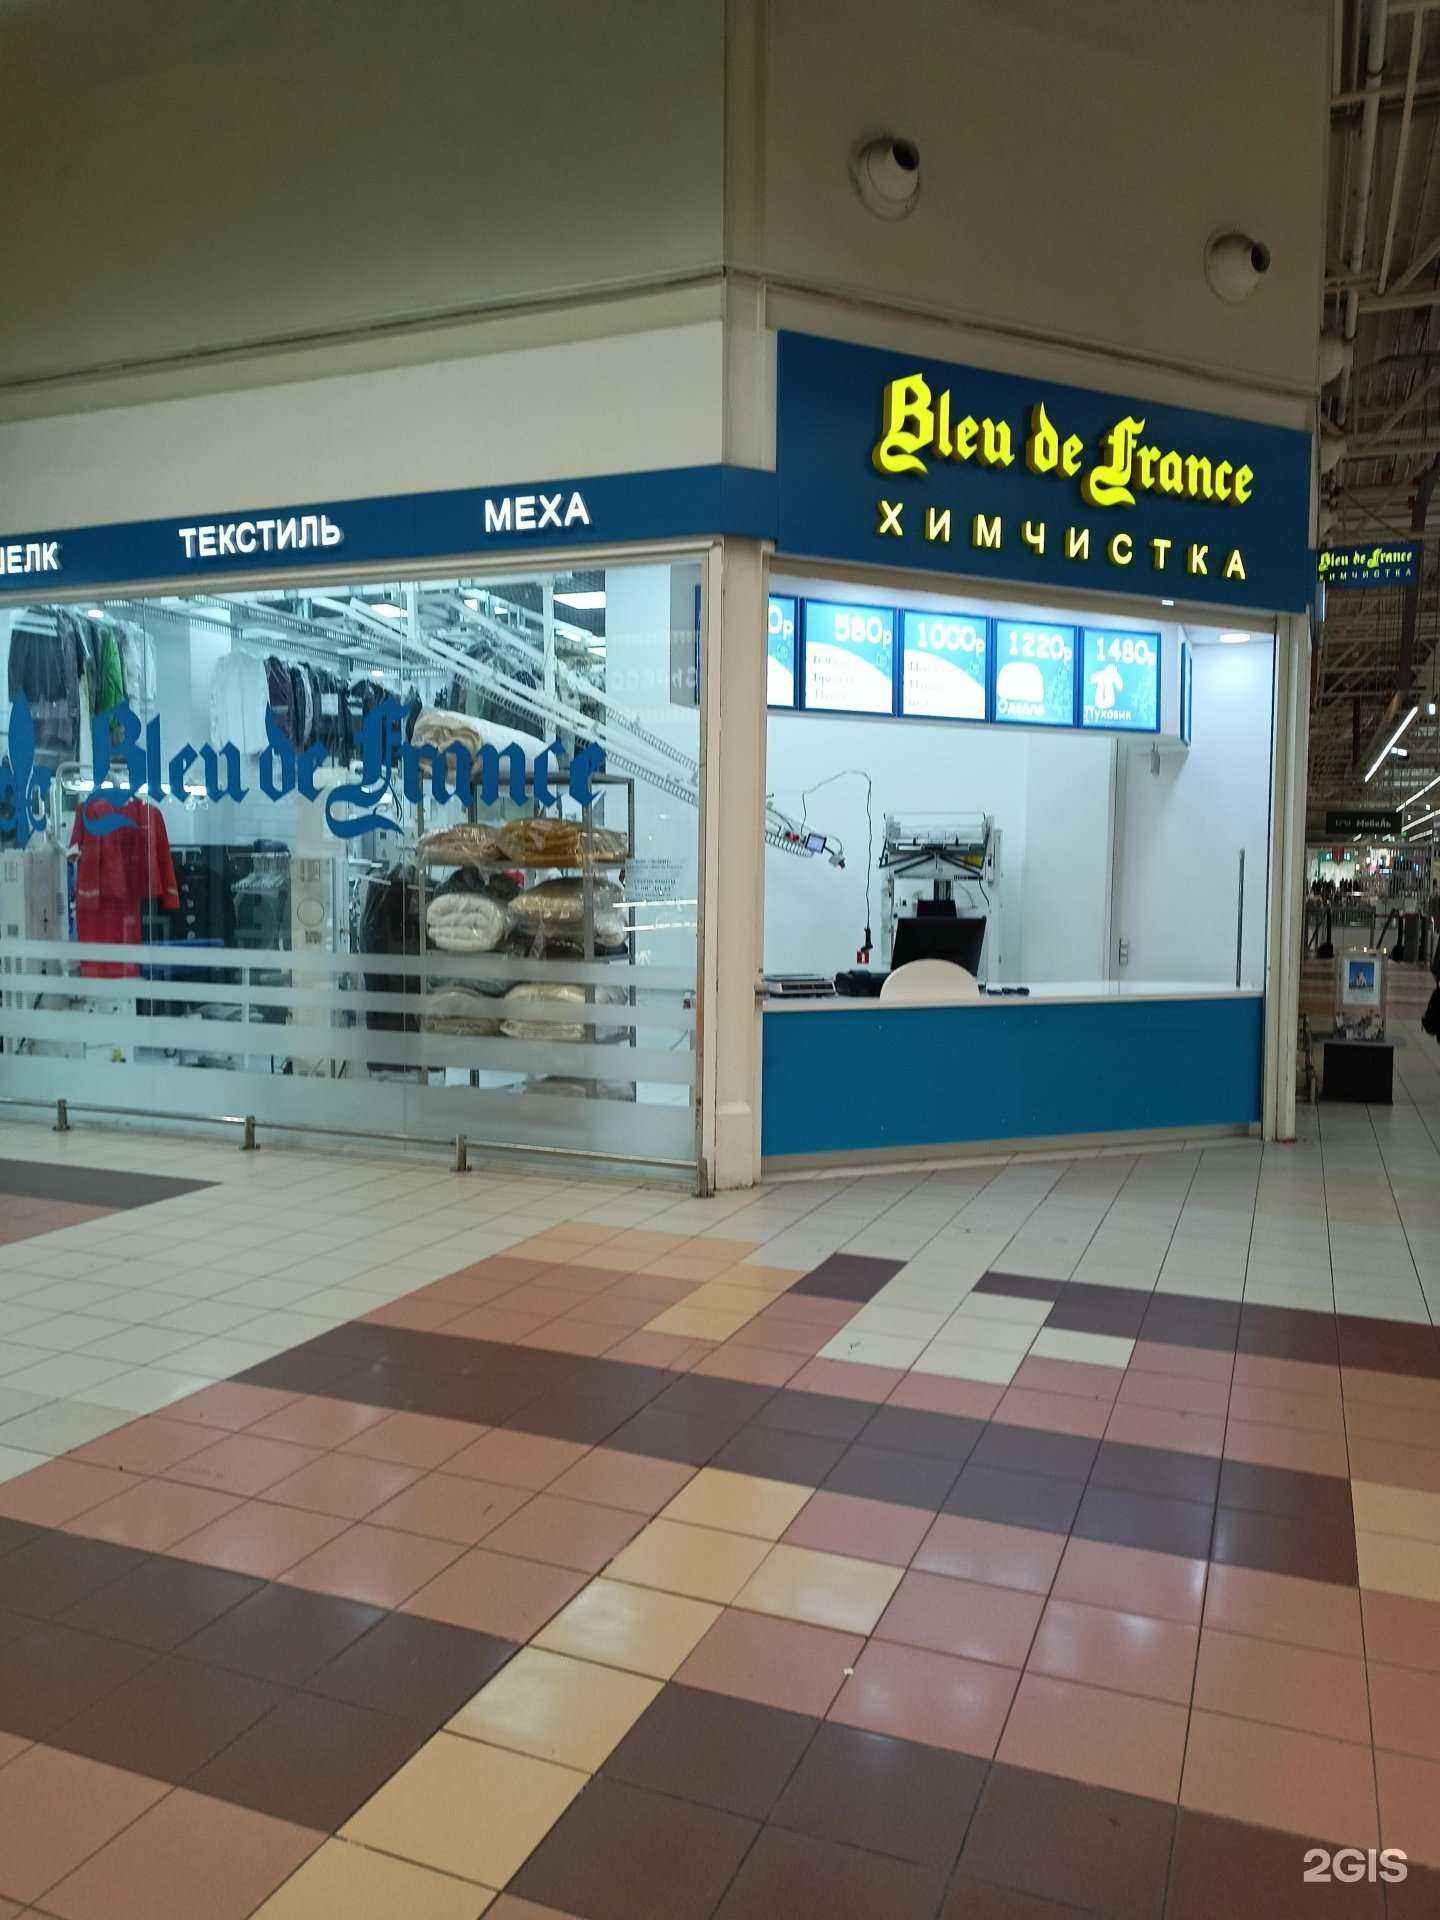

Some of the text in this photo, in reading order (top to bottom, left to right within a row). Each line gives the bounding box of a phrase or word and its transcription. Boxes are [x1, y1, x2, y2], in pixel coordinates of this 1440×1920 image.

[874, 373, 1254, 506] Bleu de France
[484, 491, 590, 533] МЕХА
[179, 514, 342, 558] ТЕКСТИЛЬ
[878, 500, 1247, 580] ХИМЧИСТКА
[0, 541, 60, 575] ЕЛК
[834, 613, 893, 649] 580р
[916, 621, 985, 656] 1000р
[1008, 630, 1073, 665] 1220р
[83, 699, 606, 838] Bleu de France
